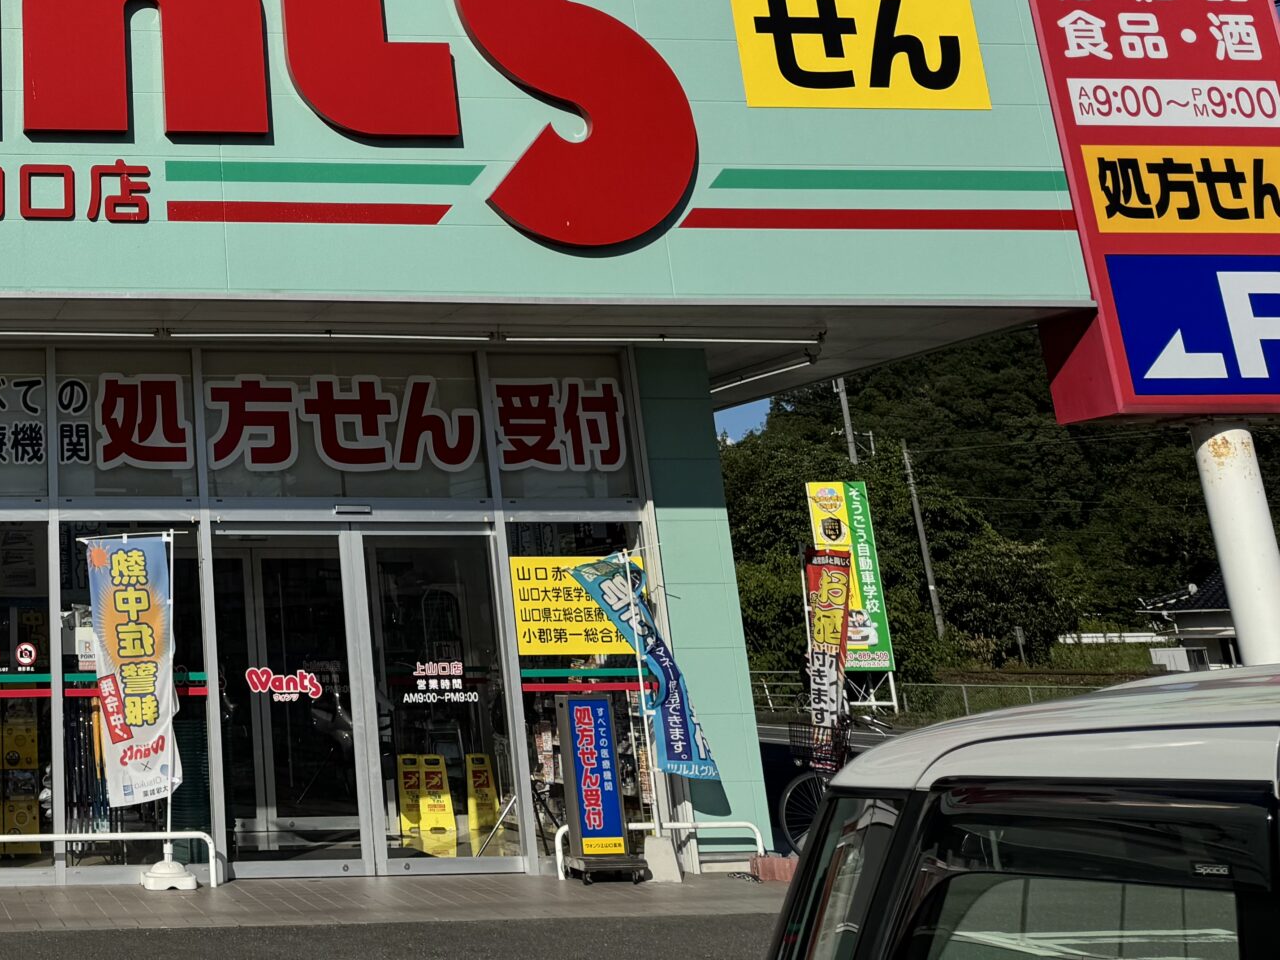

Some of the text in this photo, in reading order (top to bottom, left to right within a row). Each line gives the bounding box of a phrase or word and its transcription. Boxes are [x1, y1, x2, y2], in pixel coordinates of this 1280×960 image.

[1057, 9, 1263, 61] 食品・酒
[848, 487, 882, 614] そうごう自動車学校
[520, 607, 612, 623] 山口県立総合医療
[245, 666, 323, 700] Wants
[413, 661, 464, 677] 上山口店
[416, 679, 463, 691] 営業時間
[272, 692, 300, 703] ウォンツ
[596, 707, 614, 791] すべての医療機関
[574, 705, 604, 830] 処方せん受付
